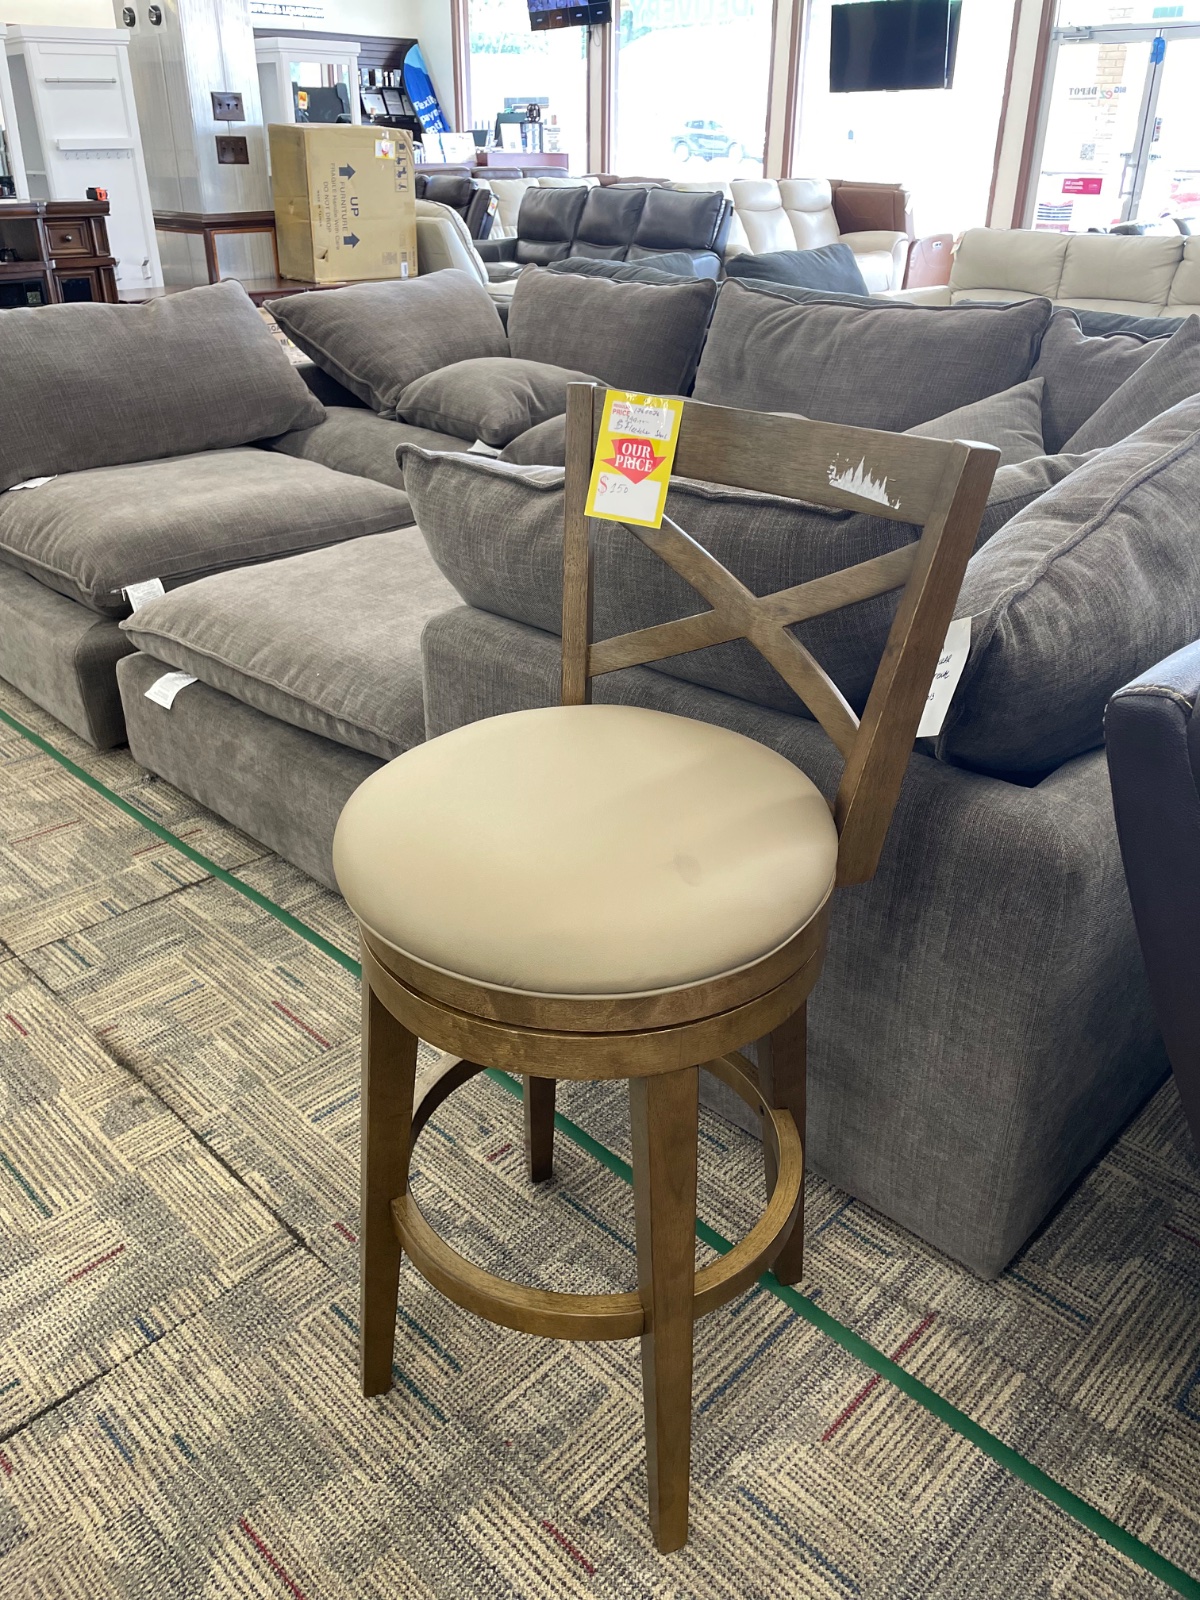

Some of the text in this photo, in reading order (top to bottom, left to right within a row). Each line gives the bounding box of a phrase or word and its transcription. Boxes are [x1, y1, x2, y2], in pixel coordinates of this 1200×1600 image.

[323, 181, 329, 192] DO
[340, 181, 348, 232] FURNITURE
[350, 196, 359, 217] UP
[612, 409, 631, 417] PRICE
[621, 442, 651, 459] OUR
[614, 455, 654, 473] PRICE
